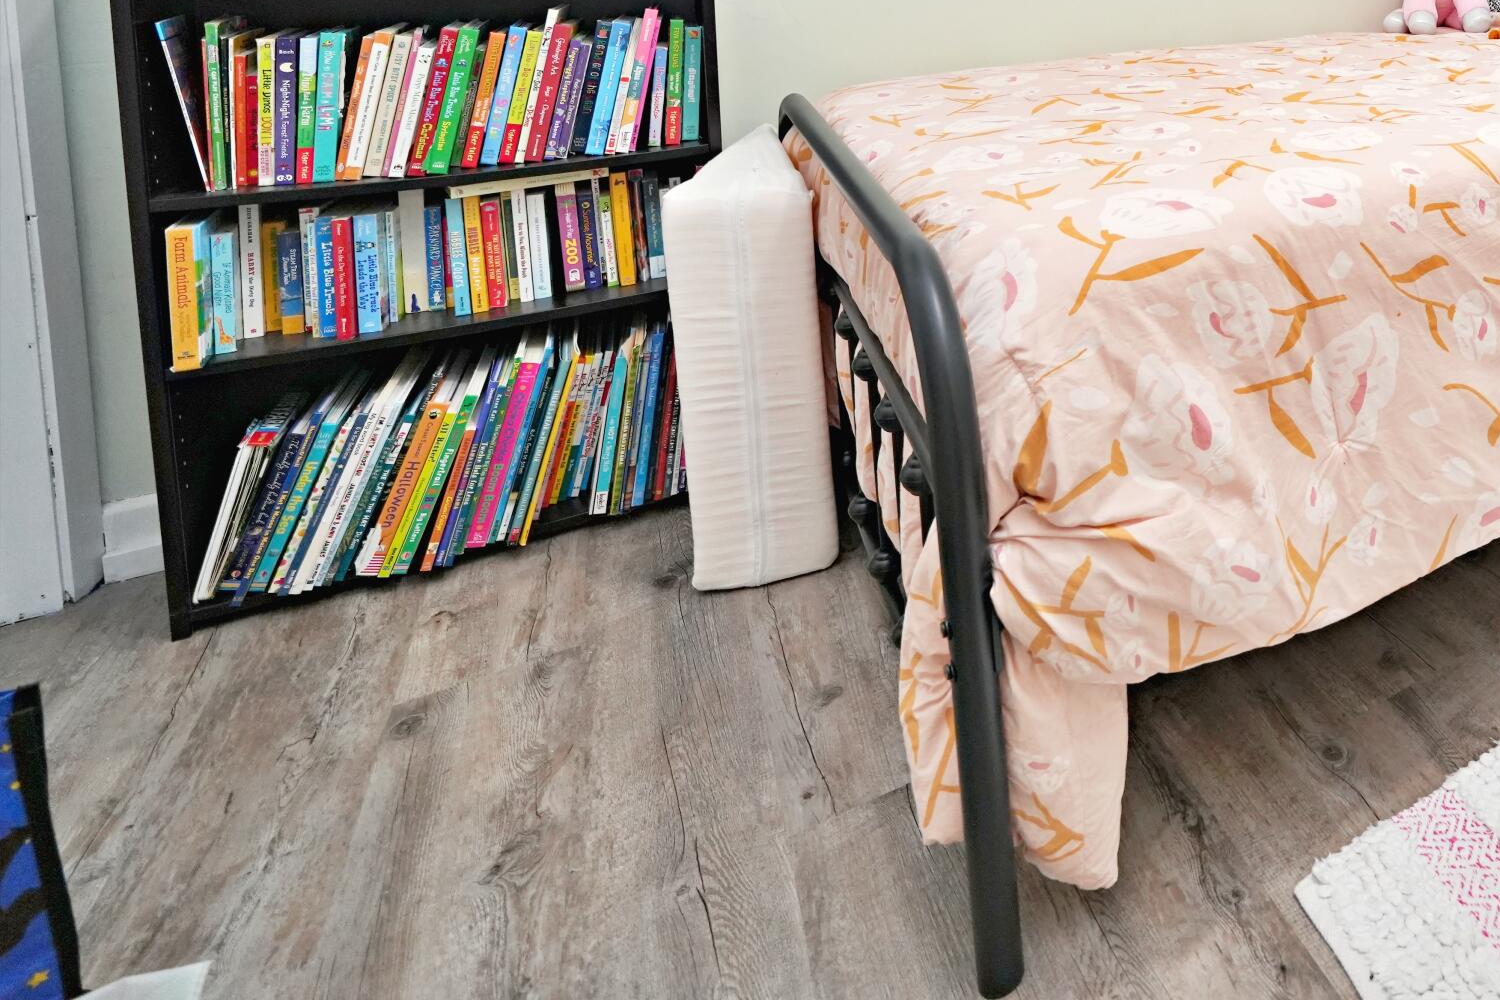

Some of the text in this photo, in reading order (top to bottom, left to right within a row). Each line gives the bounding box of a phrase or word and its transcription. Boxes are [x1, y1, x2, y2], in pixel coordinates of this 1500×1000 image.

[261, 69, 272, 89] Little
[558, 46, 579, 106] Fingerwiggly Elephants
[211, 93, 219, 116] Christmas
[385, 84, 397, 103] SPIDER
[280, 120, 288, 137] Forest
[414, 122, 432, 160] Christmas
[436, 120, 451, 151] Springtime
[469, 129, 479, 146] tiger
[503, 128, 515, 156] tiger tales
[279, 138, 288, 158] Friends
[300, 151, 309, 165] tiger
[466, 146, 475, 162] tales
[449, 231, 461, 258] NIBBLES
[581, 208, 595, 263] Sunrise, Moonrise
[173, 236, 188, 263] Farm
[426, 224, 445, 290] BARNYARD DANCE!
[564, 238, 578, 264] ZOO
[222, 269, 232, 293] Animals
[321, 241, 335, 315] Little Blue Truck
[356, 259, 366, 280] Leads
[367, 254, 379, 312] Little Blue Truck
[175, 265, 191, 308] Animals
[357, 294, 368, 310] Way
[439, 421, 450, 434] All
[485, 461, 503, 494] Boom
[275, 457, 319, 537] Under the Sea
[358, 468, 388, 528] THE CAT IN THE HAT
[380, 456, 421, 533] Halloween
[407, 446, 454, 543] Fingertrail Big Letters
[475, 492, 493, 524] Boom
